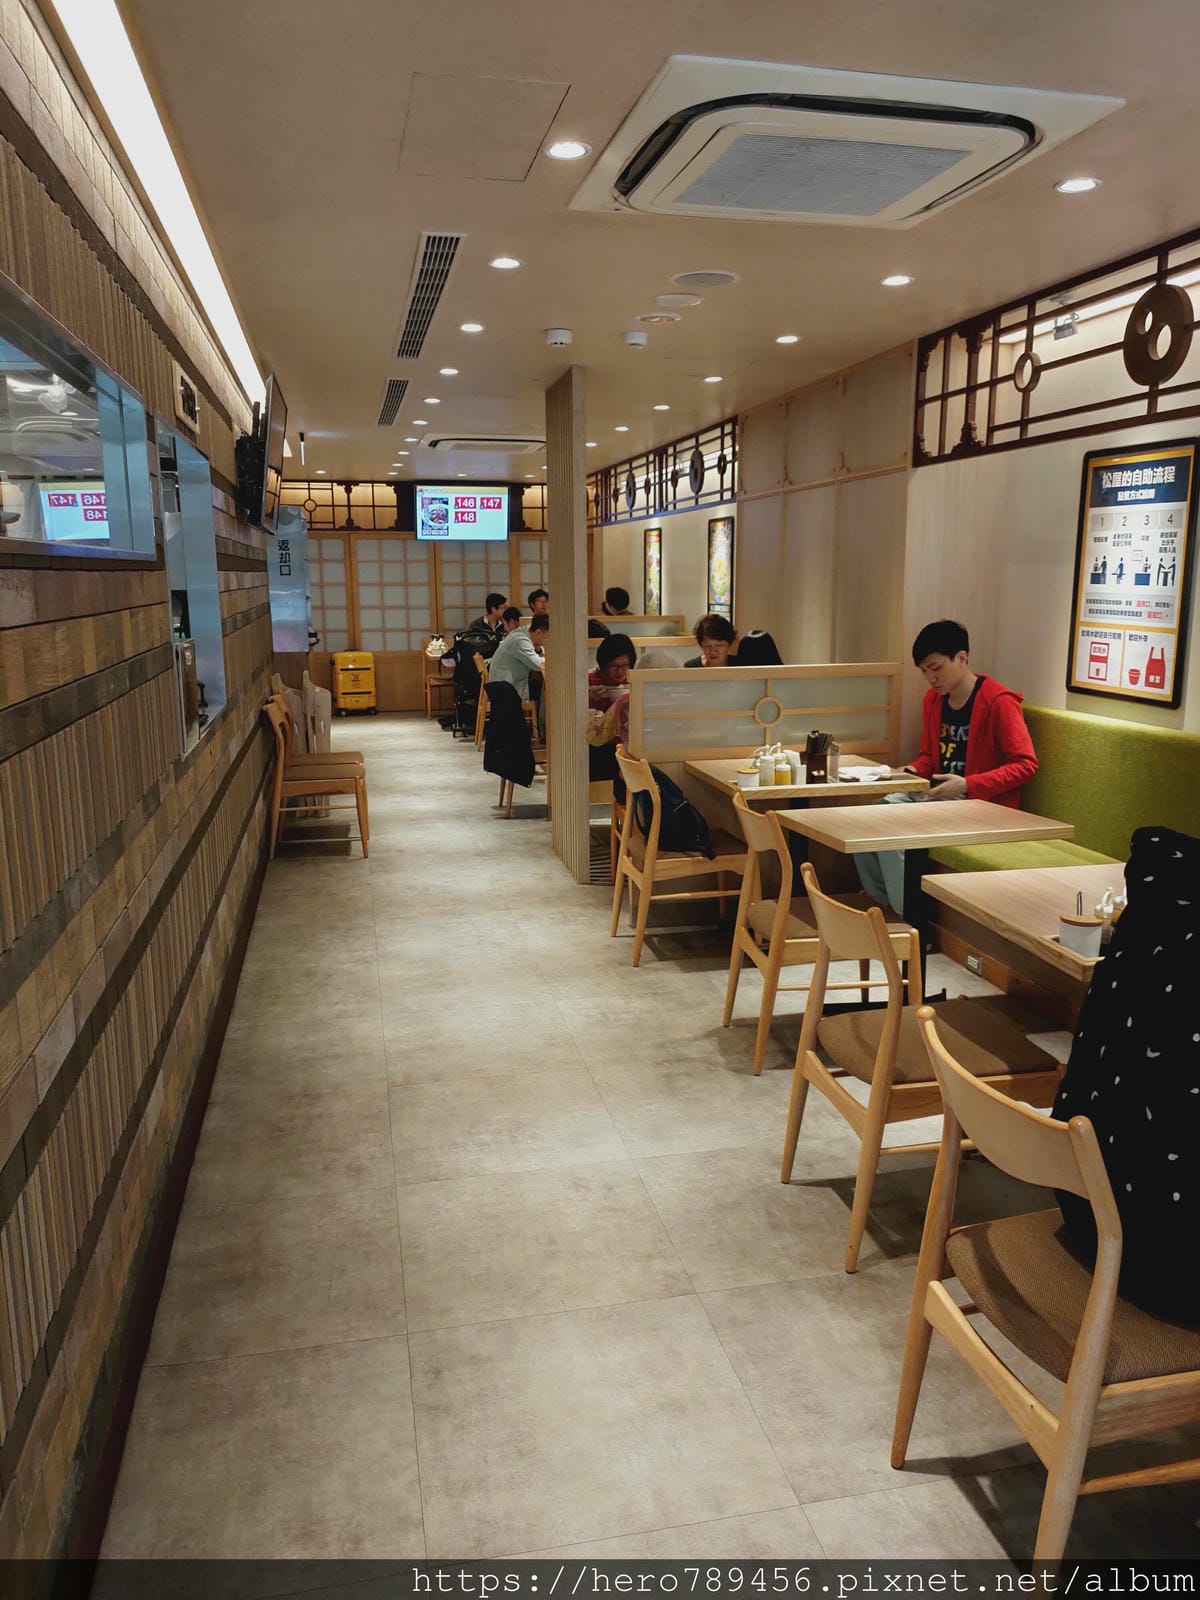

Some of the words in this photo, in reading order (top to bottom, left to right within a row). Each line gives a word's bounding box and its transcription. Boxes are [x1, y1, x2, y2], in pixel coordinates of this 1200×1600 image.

[1102, 466, 1176, 488] 松屋的自助流程
[456, 498, 475, 508] 146
[482, 498, 500, 508] 147
[456, 512, 475, 522] 148
[1121, 515, 1128, 527] 2
[1144, 514, 1150, 526] 3
[1167, 513, 1174, 525] 4
[278, 539, 291, 576] 返却口
